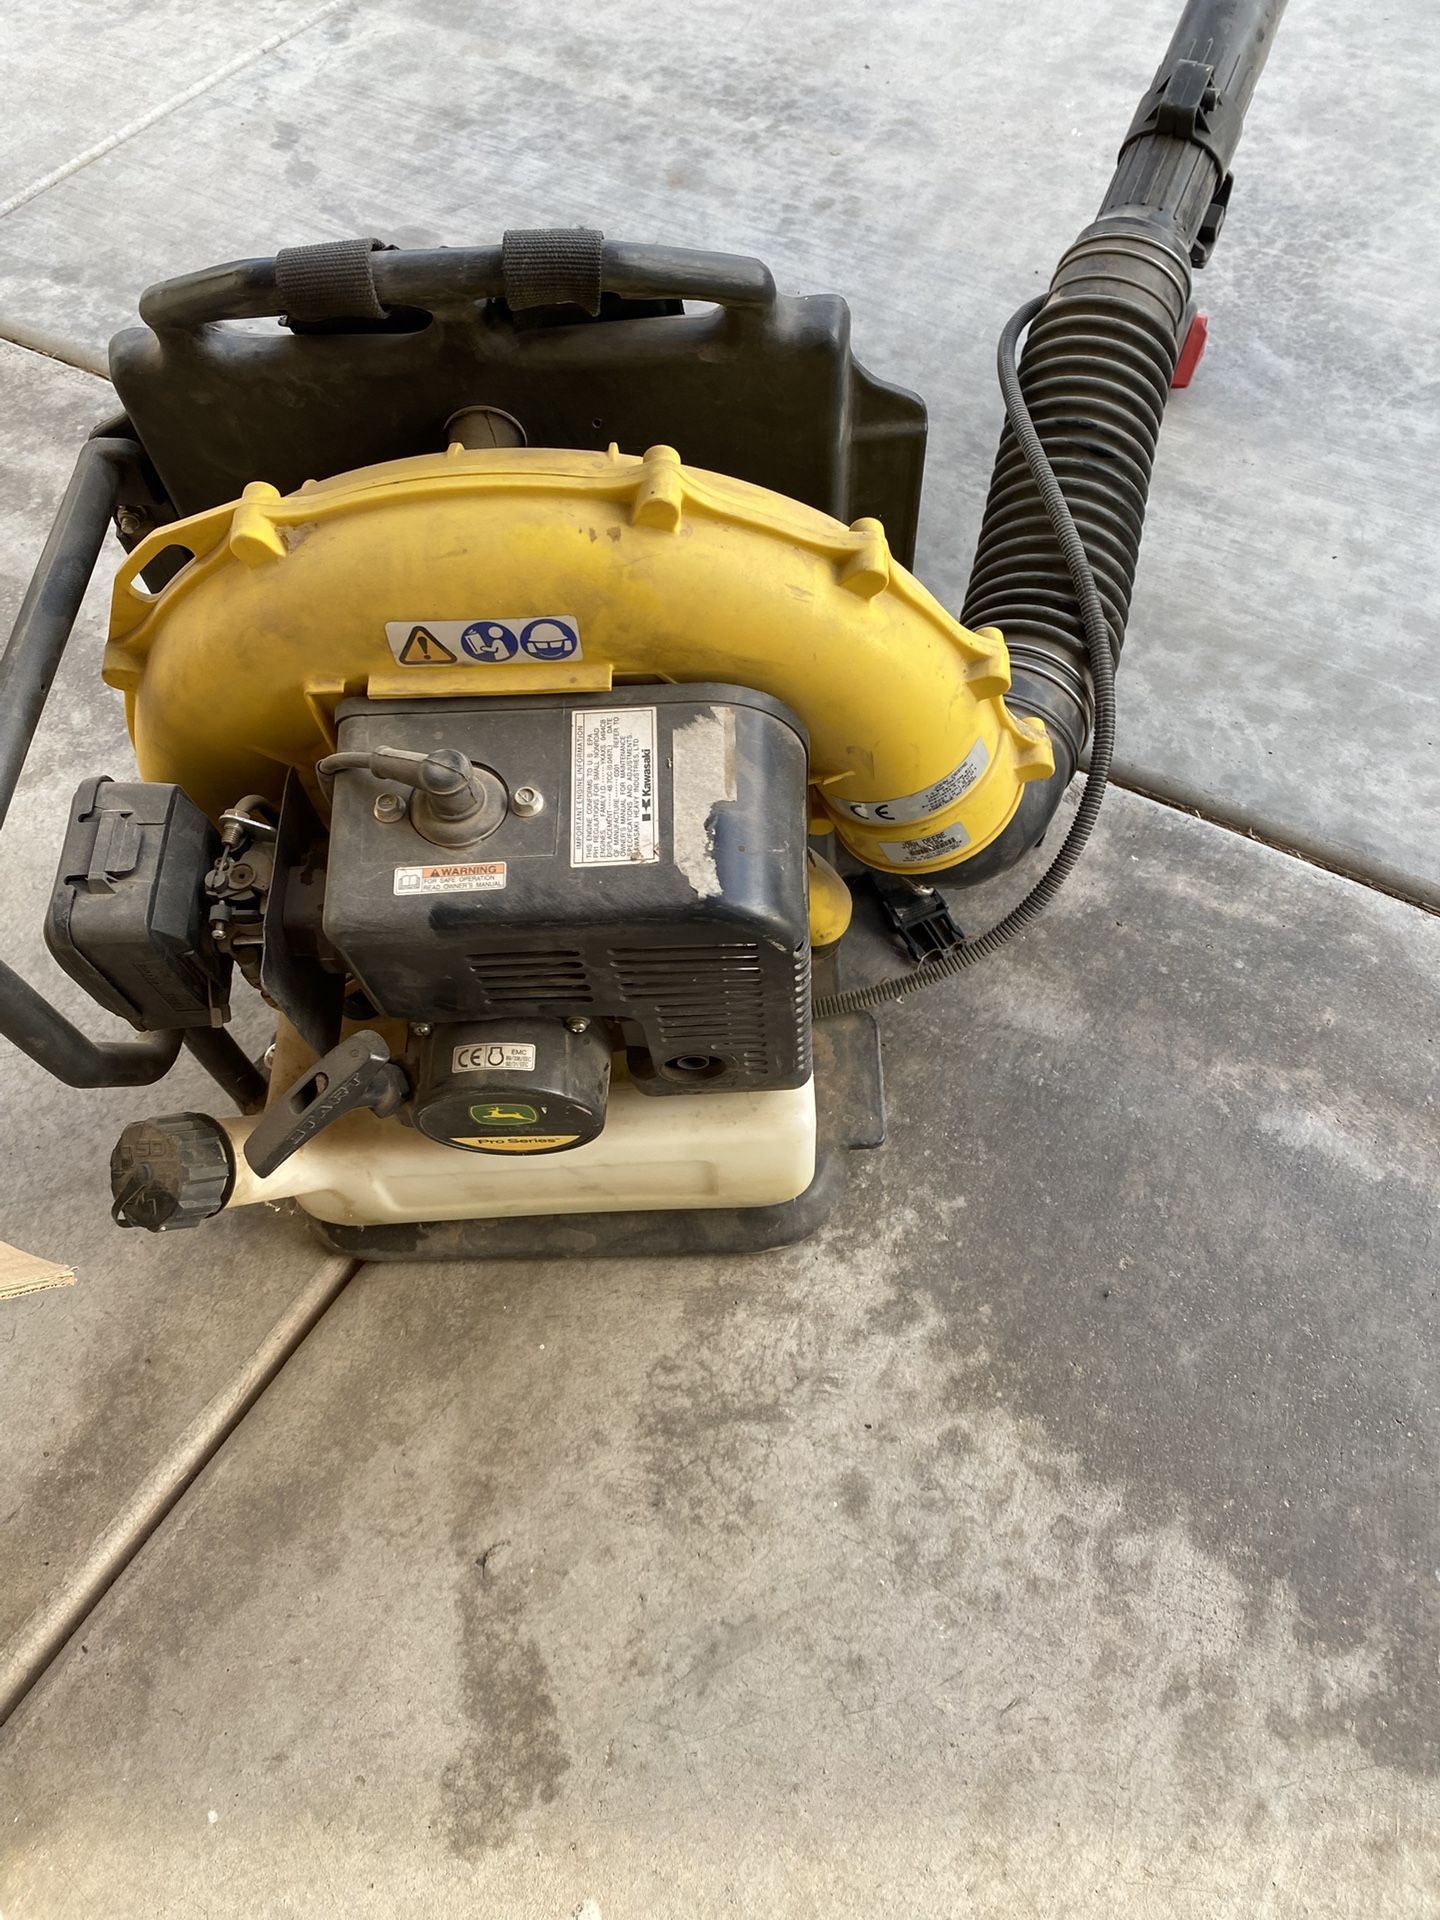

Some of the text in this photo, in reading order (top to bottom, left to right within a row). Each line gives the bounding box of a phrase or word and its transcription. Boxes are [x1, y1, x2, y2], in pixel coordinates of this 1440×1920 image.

[613, 716, 619, 725] TO
[587, 768, 593, 777] TO
[641, 749, 651, 796] Kawasaki
[922, 831, 946, 845] DEERE
[613, 848, 619, 858] OF
[441, 865, 497, 876] WARNING
[286, 1072, 361, 1146] START
